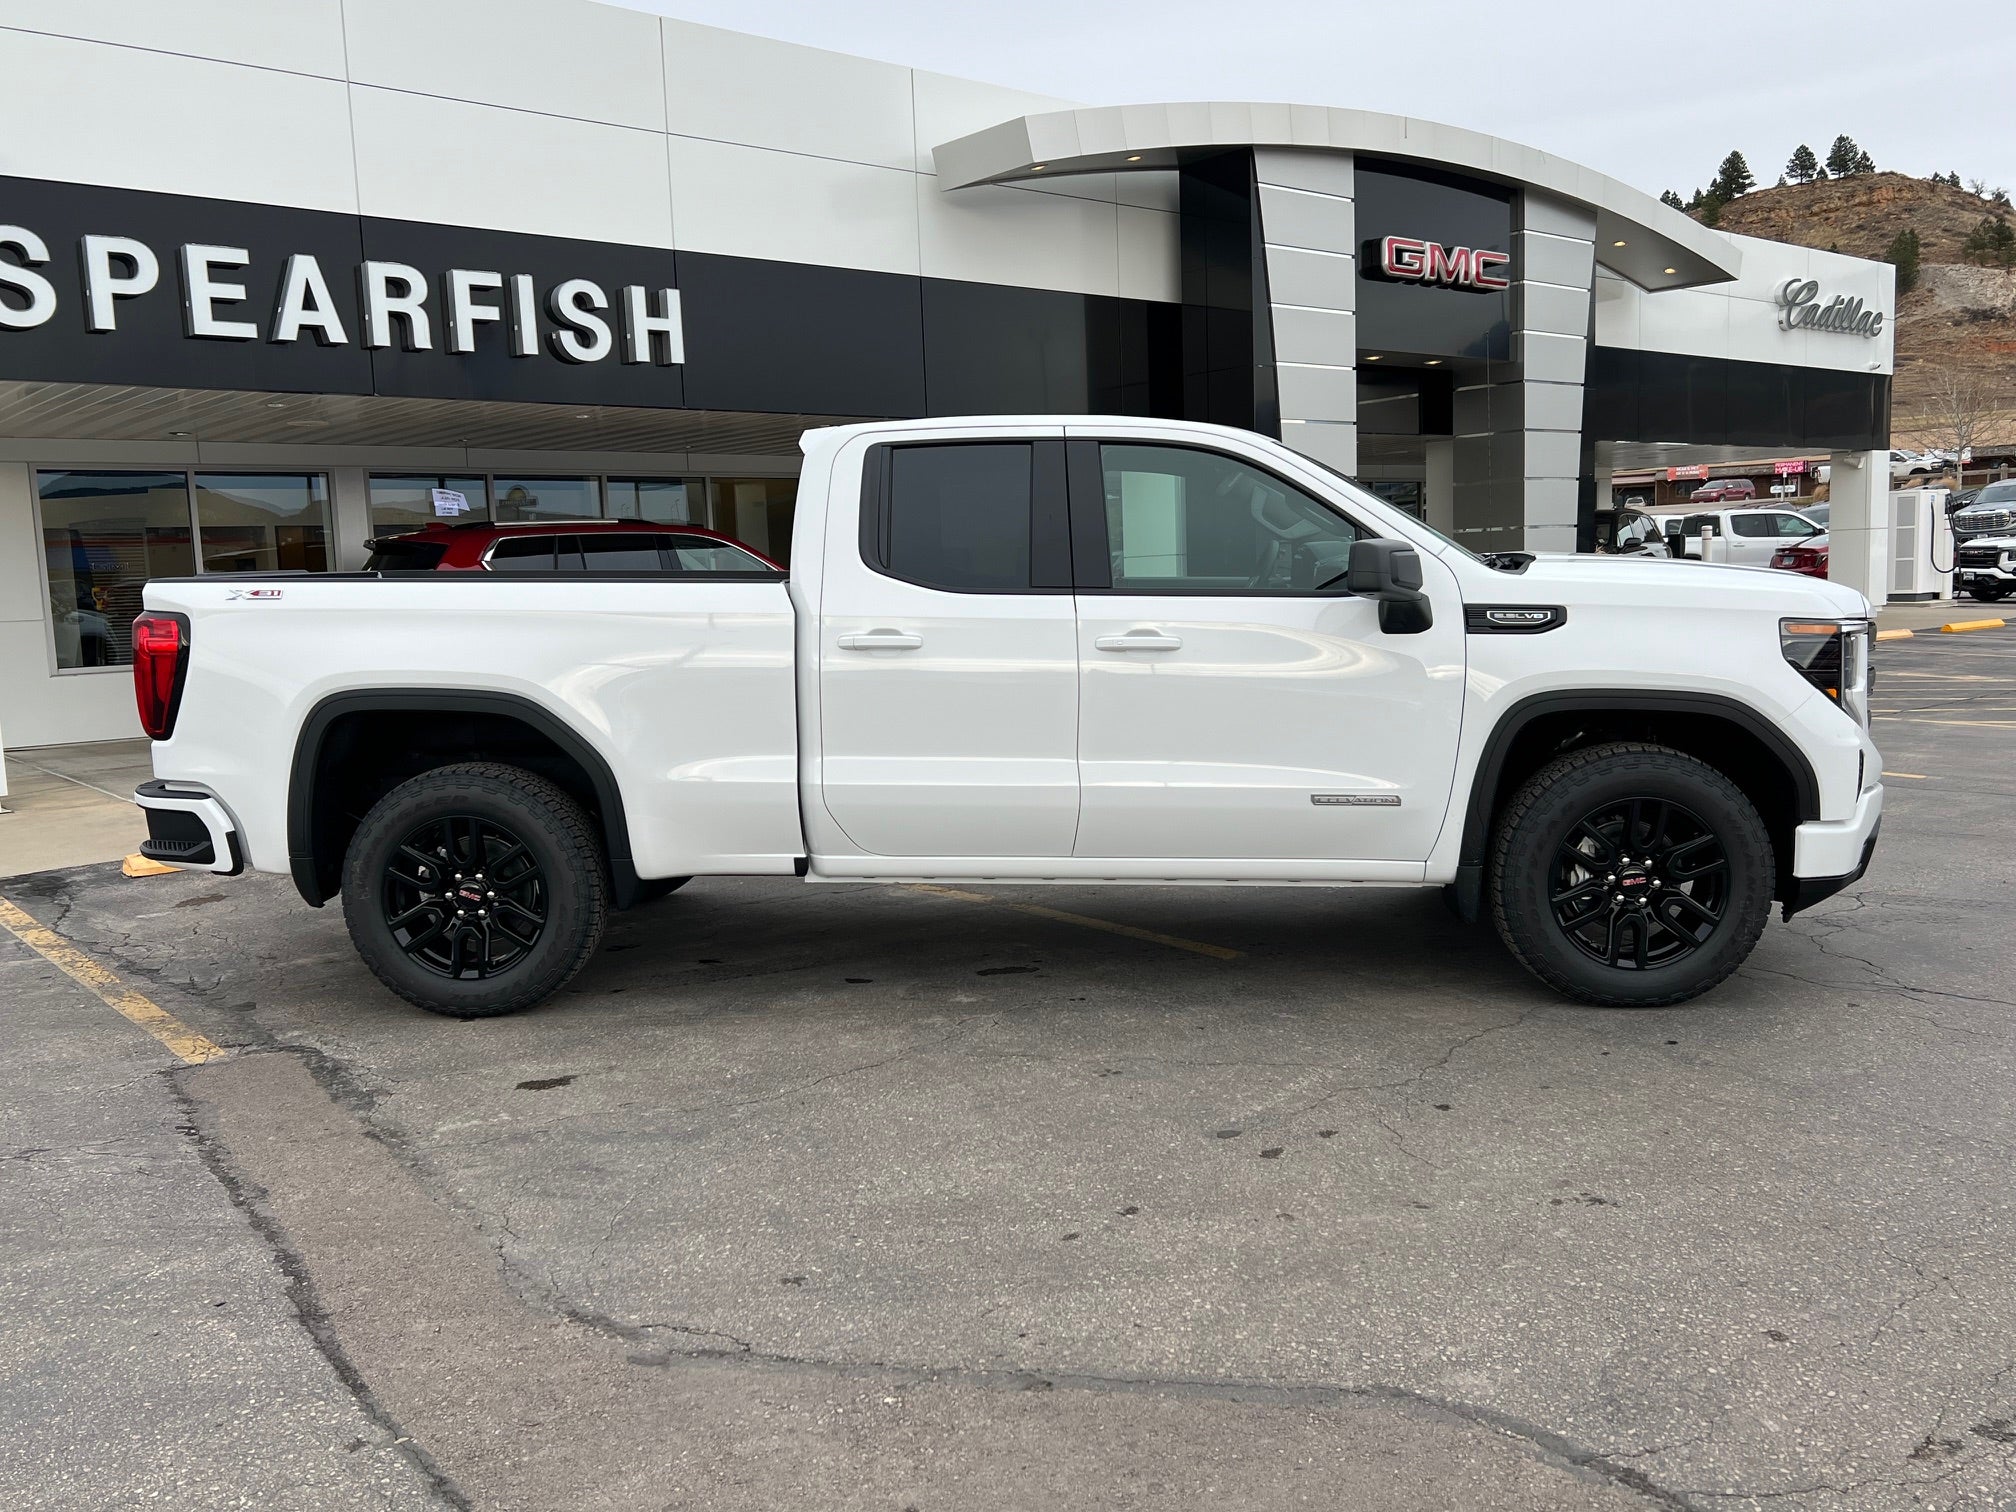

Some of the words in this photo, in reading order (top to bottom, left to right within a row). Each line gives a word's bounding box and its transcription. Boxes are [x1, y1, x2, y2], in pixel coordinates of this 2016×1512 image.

[1381, 235, 1511, 291] GMC
[0, 223, 685, 365] SPEARFISH
[1779, 278, 1883, 337] Cadillac
[458, 889, 481, 902] GMC
[1622, 876, 1647, 887] GMC
